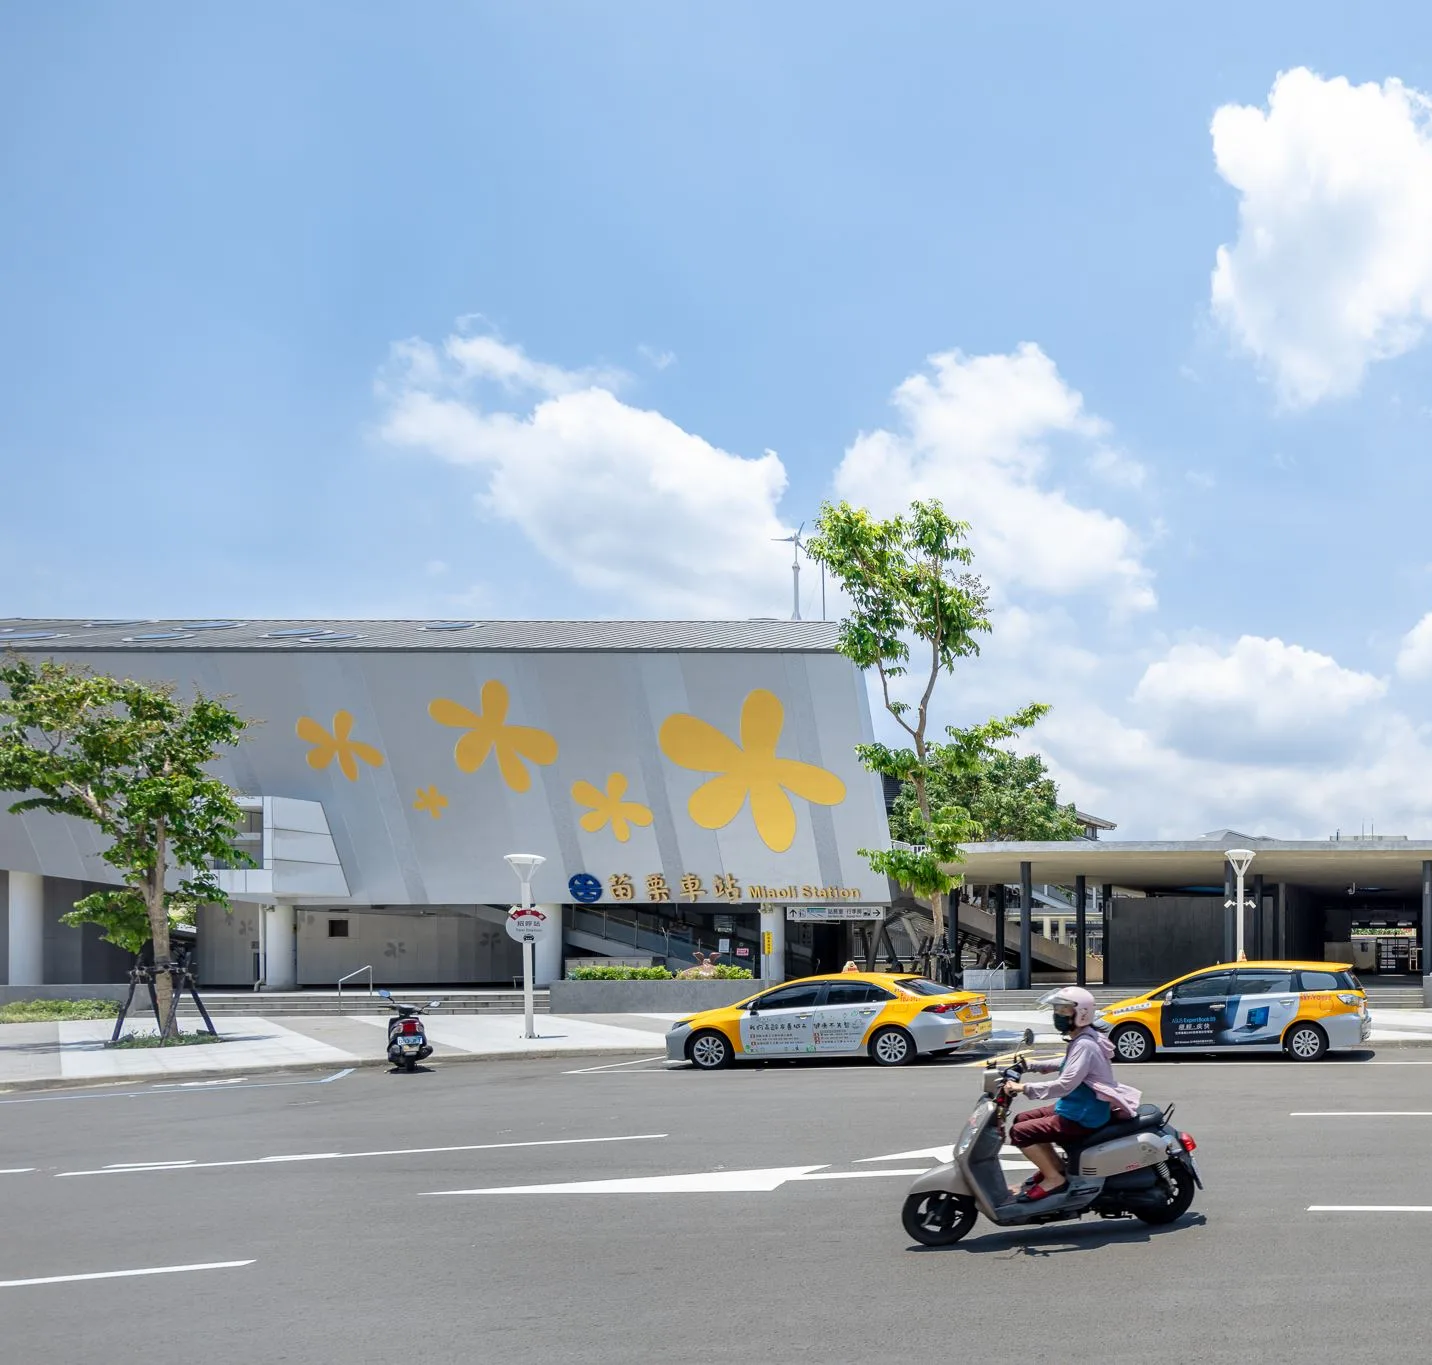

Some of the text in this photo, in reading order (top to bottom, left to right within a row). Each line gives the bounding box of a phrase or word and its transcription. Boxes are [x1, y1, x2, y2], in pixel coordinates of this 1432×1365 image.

[608, 873, 743, 904] 苗栗車站
[748, 885, 861, 899] Miaoli Station
